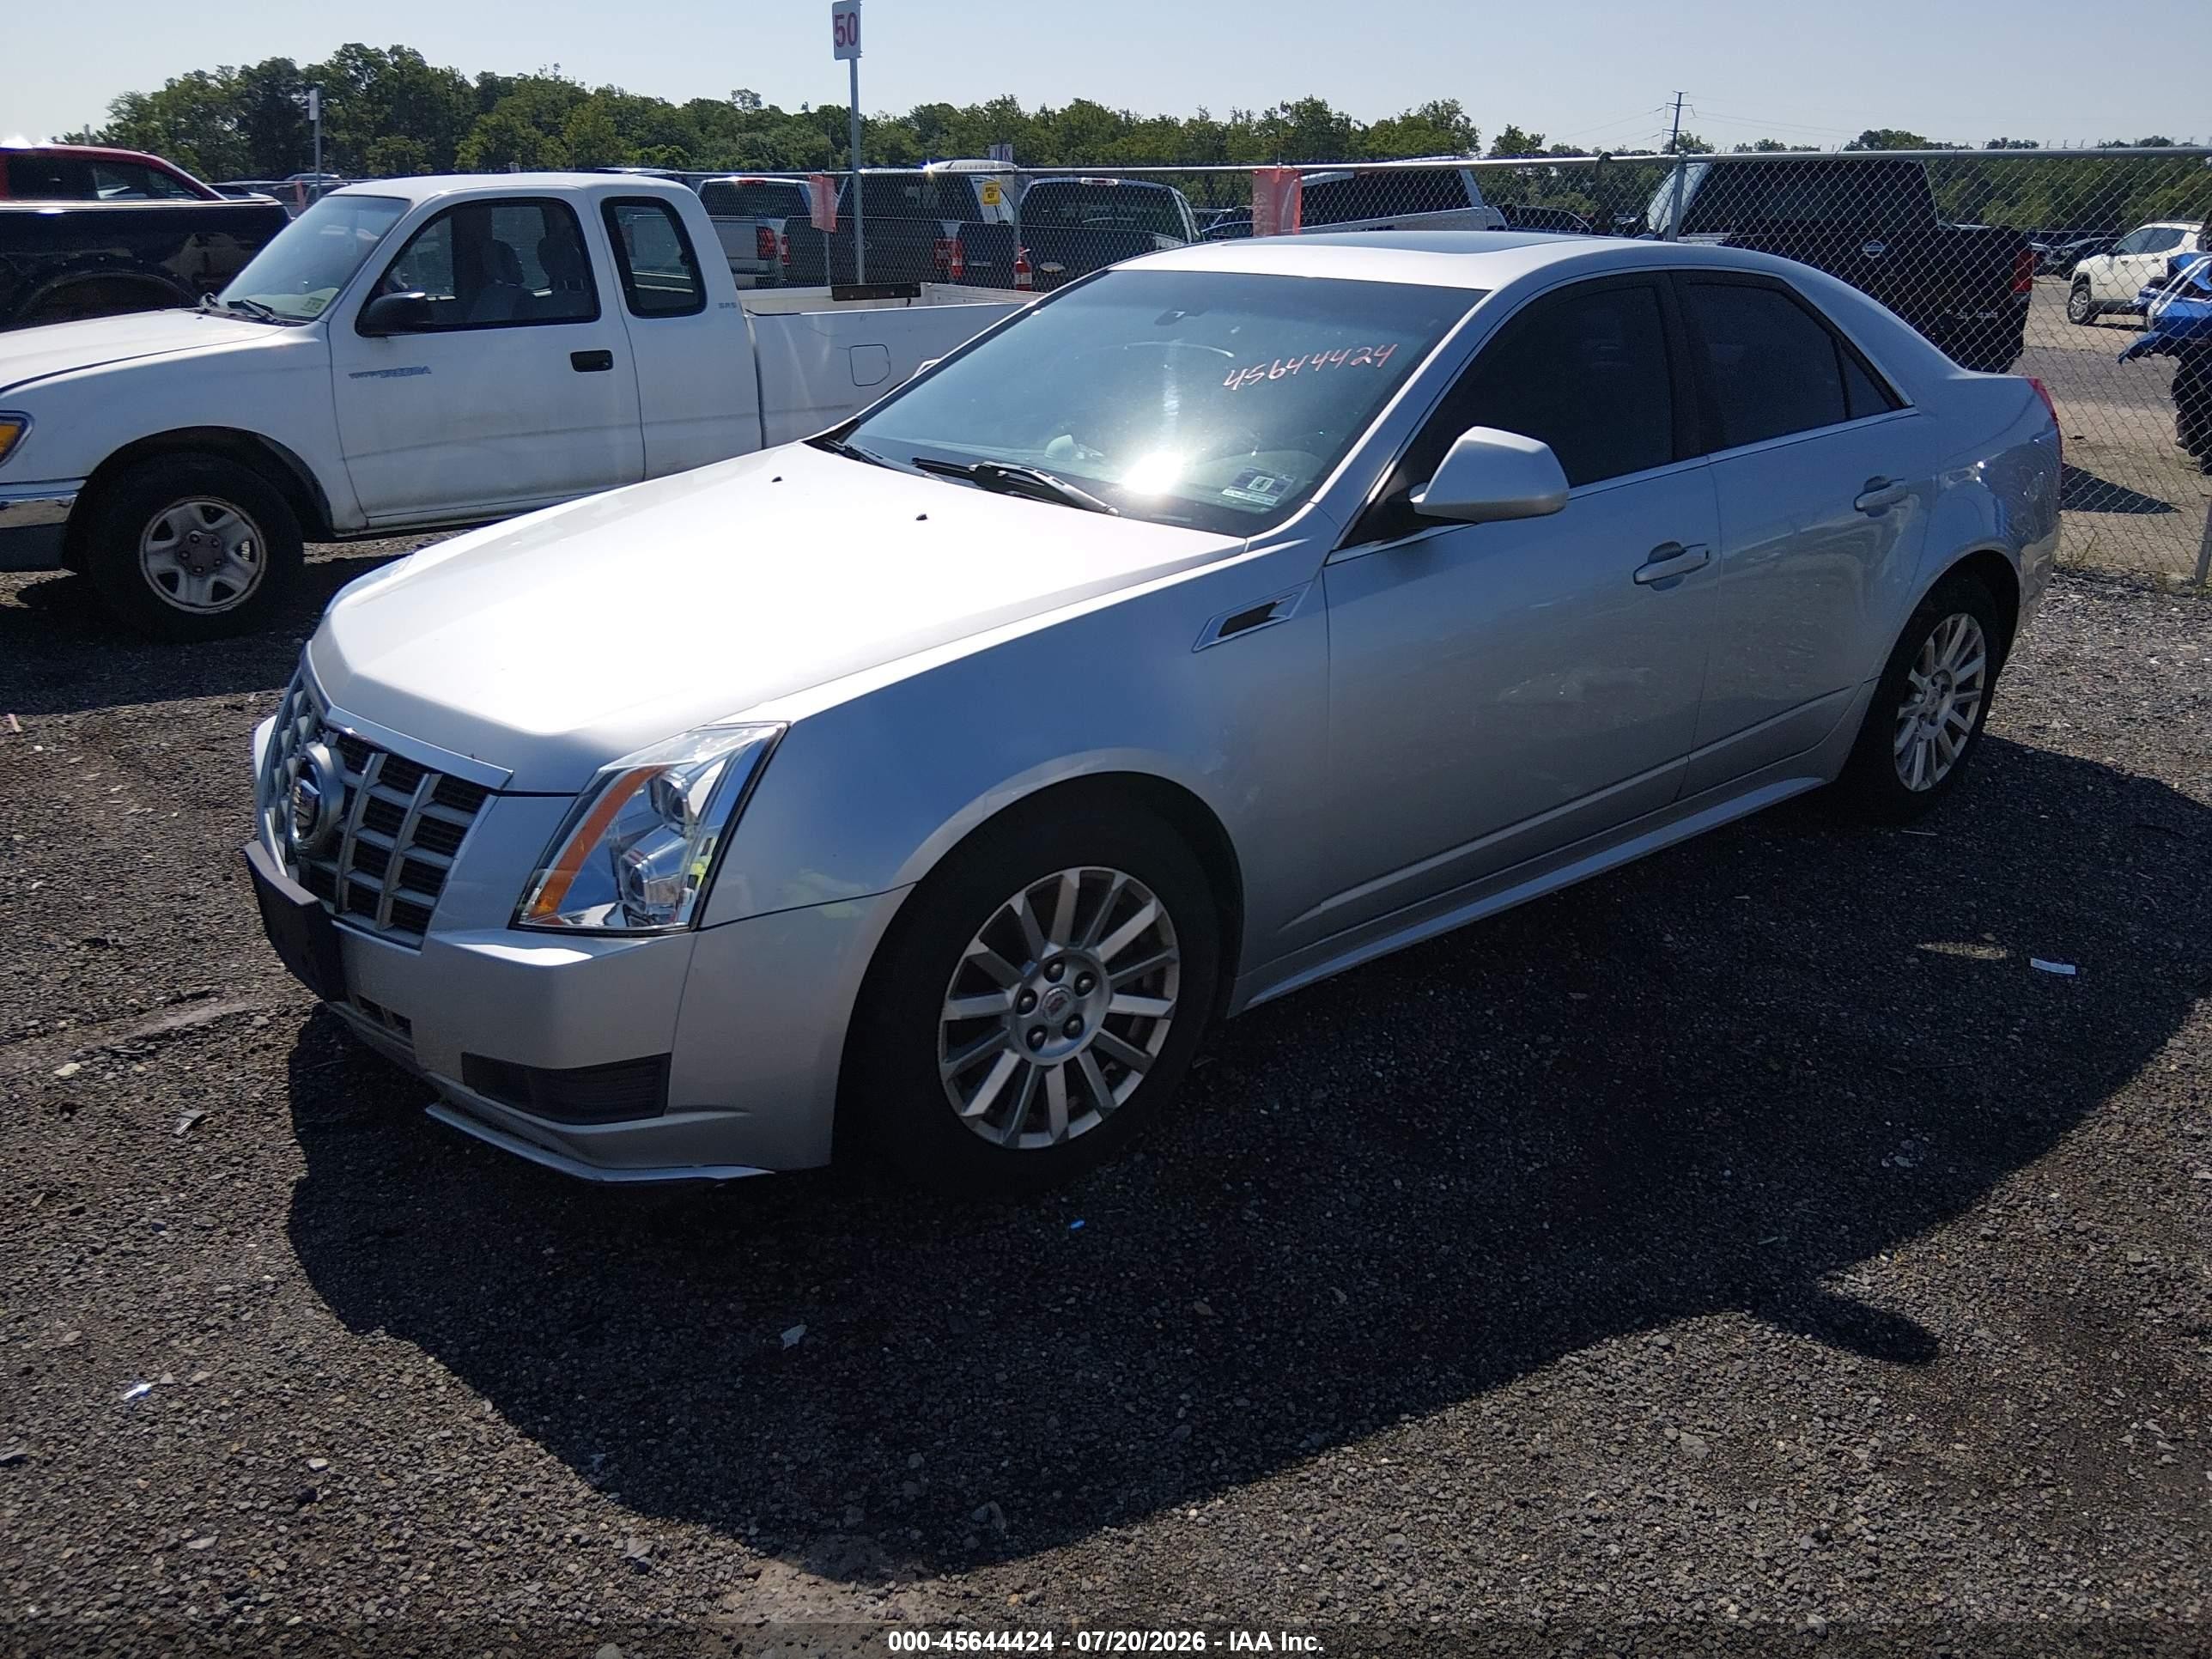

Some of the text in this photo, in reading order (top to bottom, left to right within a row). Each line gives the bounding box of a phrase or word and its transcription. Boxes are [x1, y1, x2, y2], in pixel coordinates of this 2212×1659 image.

[835, 12, 858, 47] 50
[1004, 148, 1011, 161] K
[1223, 343, 1398, 390] 45644424
